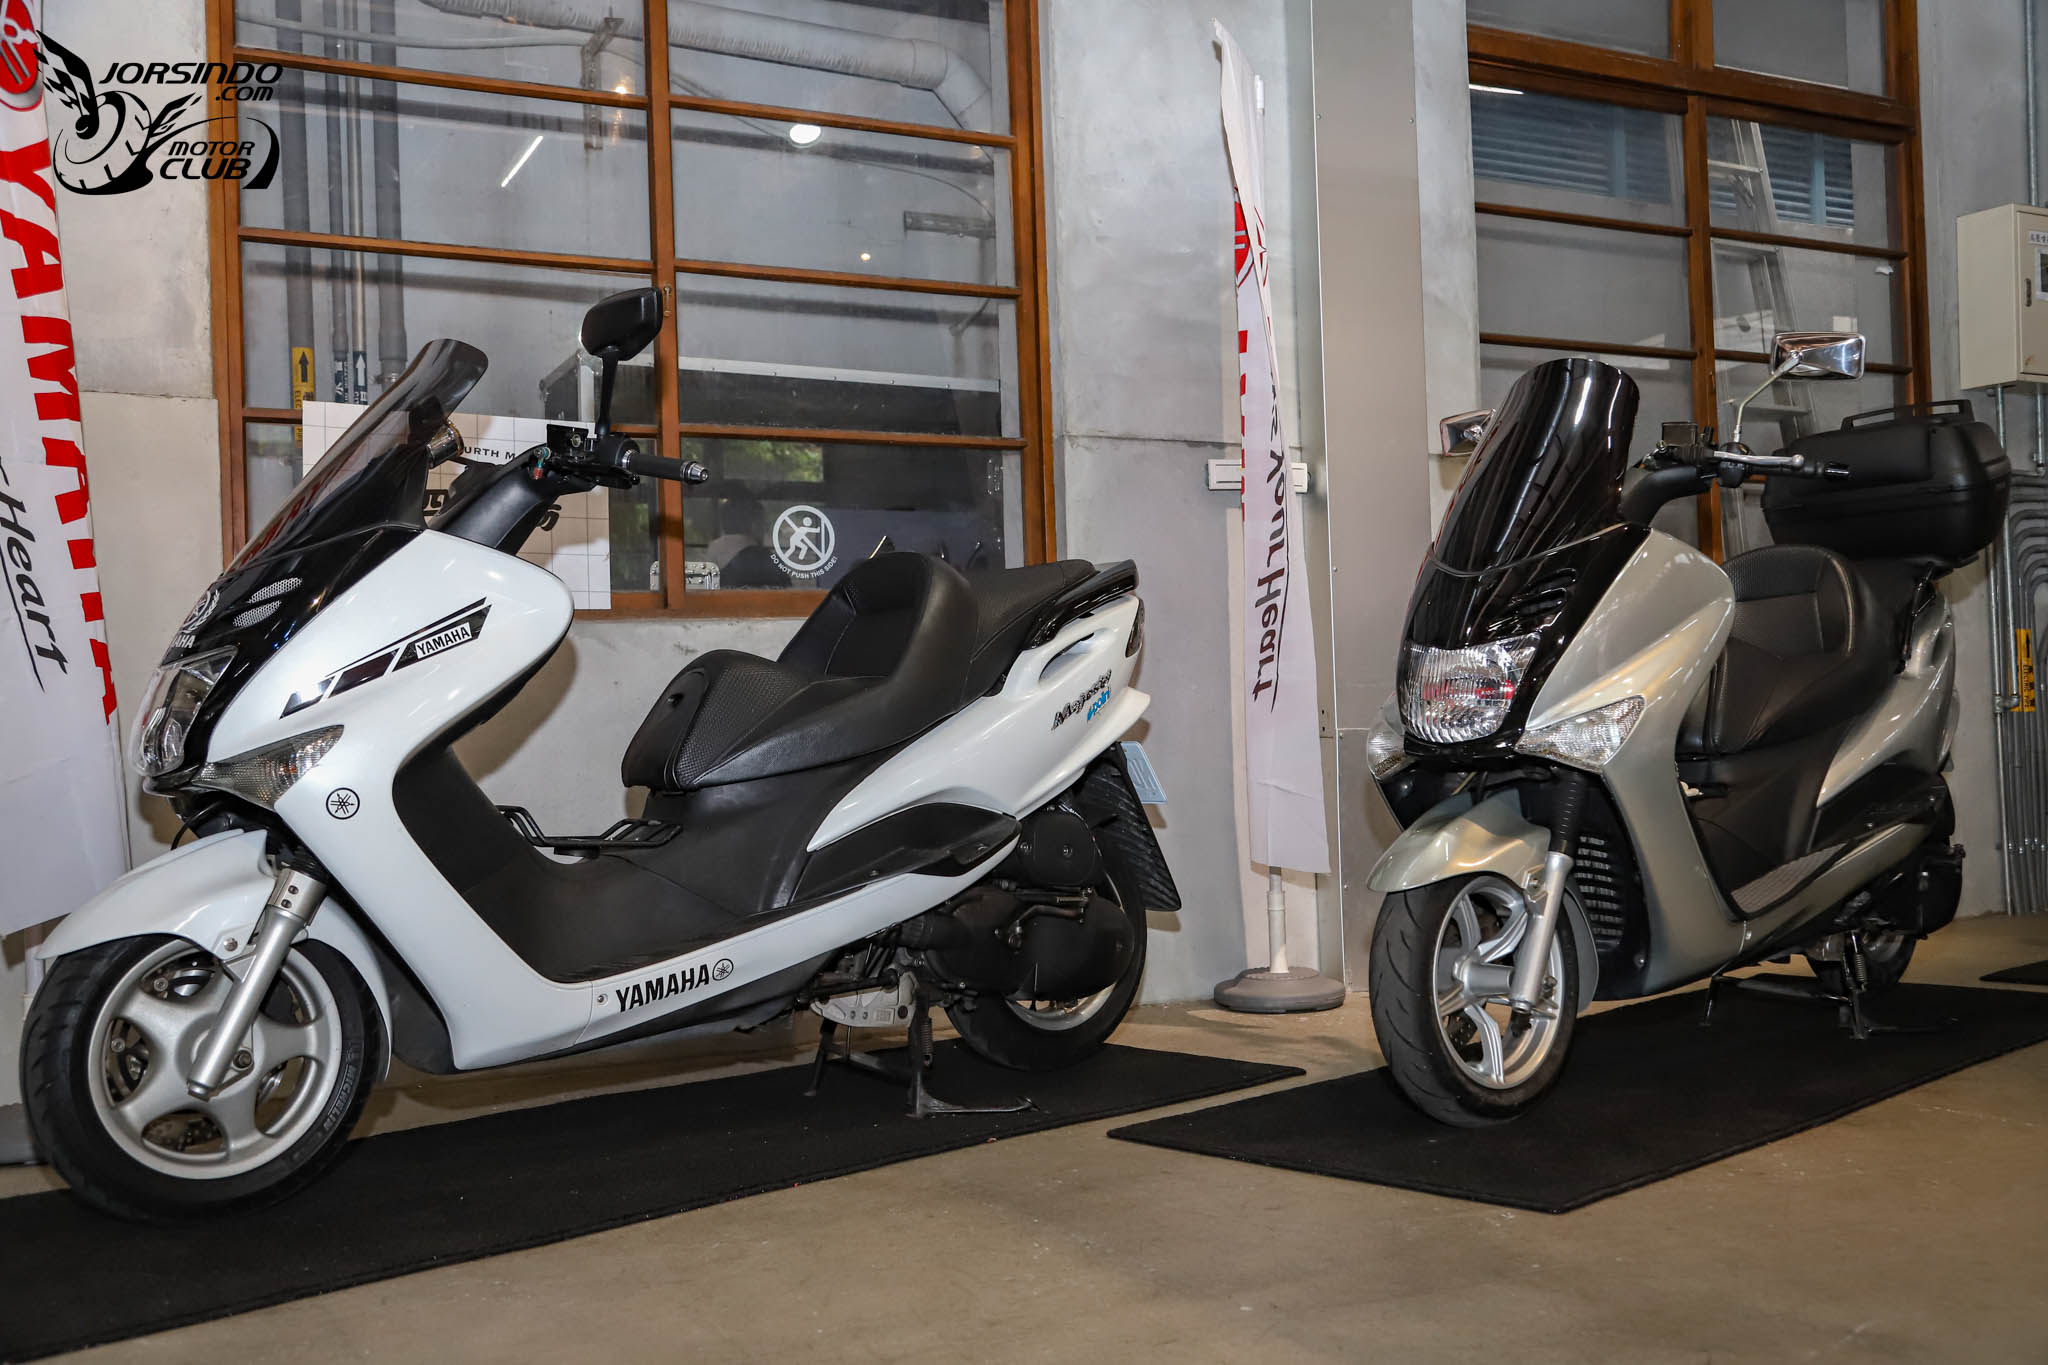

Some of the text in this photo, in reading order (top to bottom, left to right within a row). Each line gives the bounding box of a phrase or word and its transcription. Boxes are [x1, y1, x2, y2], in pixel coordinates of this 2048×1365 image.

[463, 446, 499, 458] URTH
[0, 490, 69, 675] Heart
[770, 554, 779, 564] DO
[777, 562, 791, 574] NOT
[791, 571, 810, 579] PUSH
[810, 569, 824, 577] THIS
[417, 626, 471, 655] YAMAHA
[615, 963, 710, 1013] YAMAHA
[323, 1064, 357, 1132] MICHELIN
